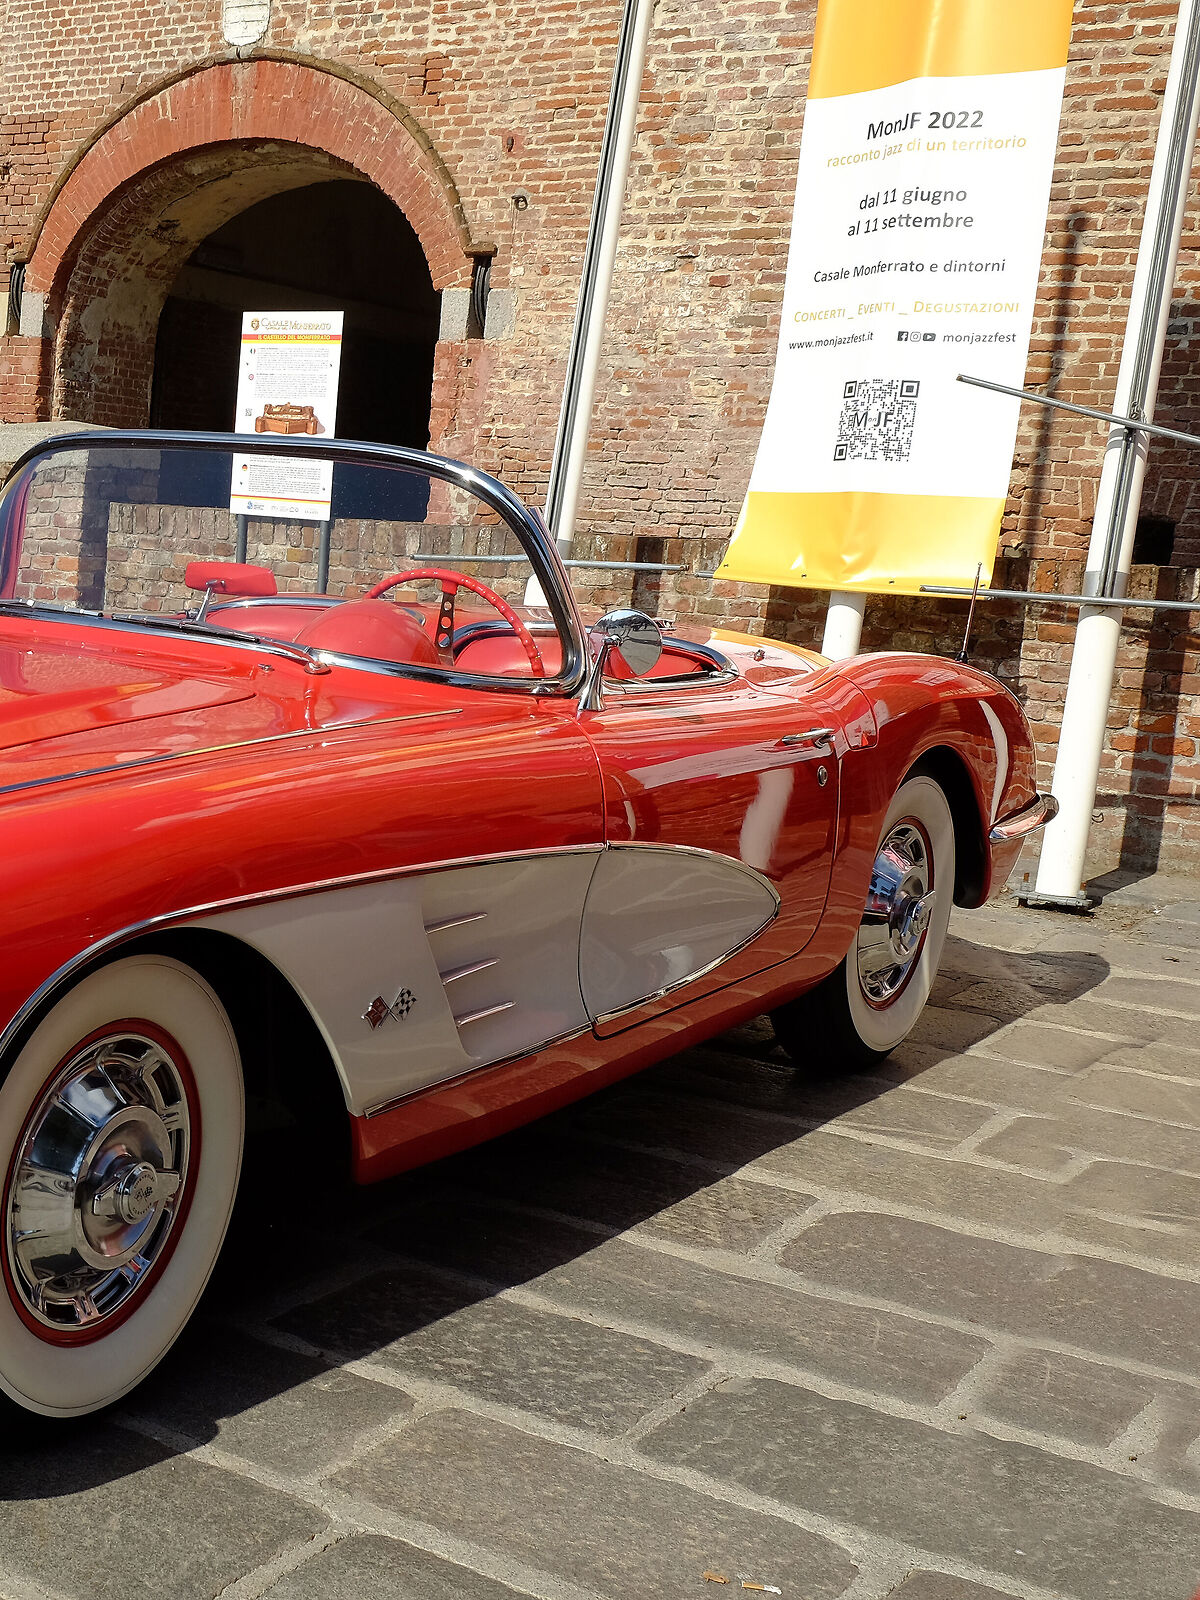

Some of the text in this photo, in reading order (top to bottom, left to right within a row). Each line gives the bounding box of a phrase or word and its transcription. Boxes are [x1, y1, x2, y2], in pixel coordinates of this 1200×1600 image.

[866, 110, 984, 140] MonJF 2022
[827, 135, 1027, 168] racconto jazz di un territorio
[859, 186, 967, 210] dal 11 giugno
[847, 212, 974, 237] al 11 settembre
[813, 258, 1006, 283] Casale Monferrato e dintorni
[793, 308, 846, 323] CONCERTI
[857, 301, 895, 316] EVENTI
[913, 300, 1019, 313] DEGUSTAZIONI
[788, 331, 874, 350] www.monjazzfest.it
[942, 331, 1017, 345] monjazzfest
